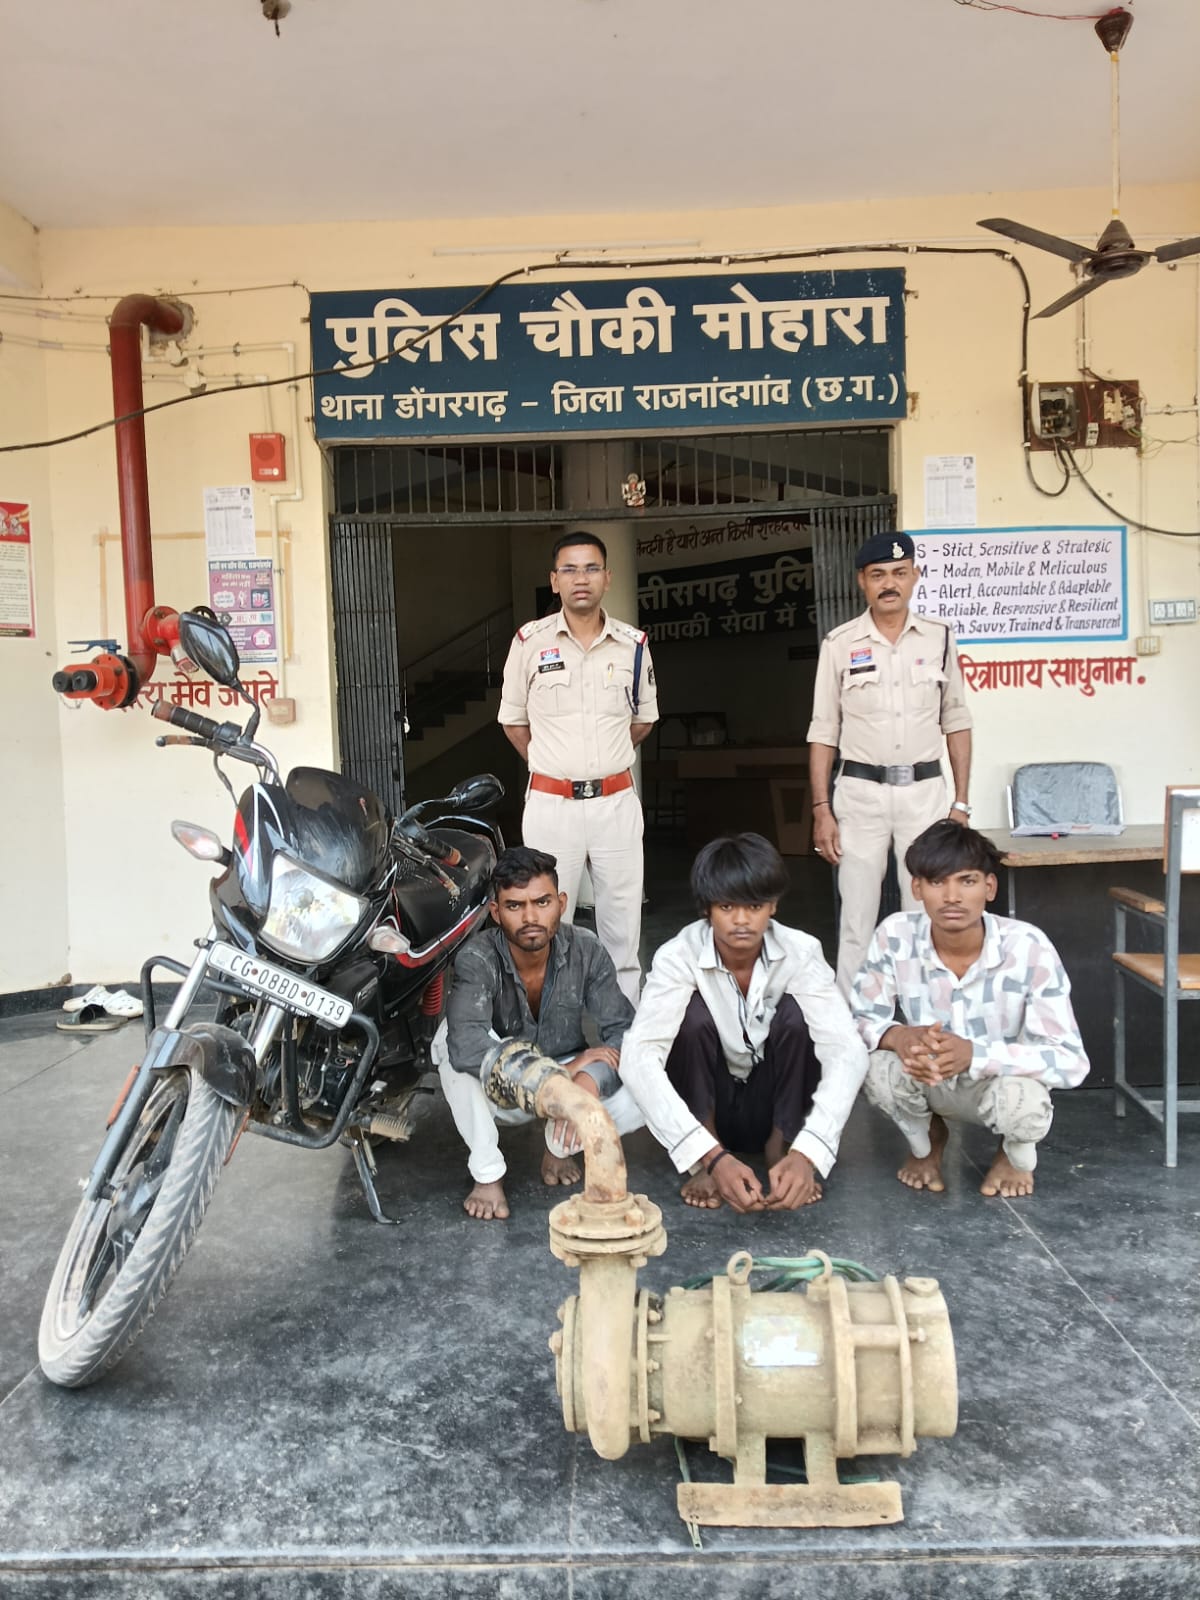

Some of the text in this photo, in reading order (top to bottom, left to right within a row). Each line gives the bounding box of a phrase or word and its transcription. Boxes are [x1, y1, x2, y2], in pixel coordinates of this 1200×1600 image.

[325, 282, 890, 379] पुलिस चौकी मोहारा
[320, 393, 384, 421] थाना
[392, 386, 508, 423] डोंगरगढ़
[551, 380, 625, 415] जिला
[633, 374, 791, 411] राजनांदगांव
[916, 543, 926, 559] S
[979, 541, 1040, 556] Sensitive
[1043, 540, 1052, 555] &
[1056, 538, 1112, 555] Strategic
[750, 556, 814, 604] पुलि
[986, 561, 1025, 577] Mobile
[1027, 561, 1037, 576] &
[1040, 559, 1108, 576] Meticulous
[917, 584, 928, 600] A
[977, 581, 1046, 598] Accountable
[1048, 580, 1057, 596] &
[1058, 579, 1112, 596] Adaptable
[718, 609, 768, 634] सेवा
[775, 602, 797, 628] में
[992, 601, 1057, 616] Responsive
[1058, 598, 1067, 614] &
[1068, 596, 1118, 613] Resilient
[1009, 616, 1053, 632] Trained
[1055, 616, 1063, 631] &
[1065, 613, 1121, 631] Transparent
[169, 671, 214, 708] मेव
